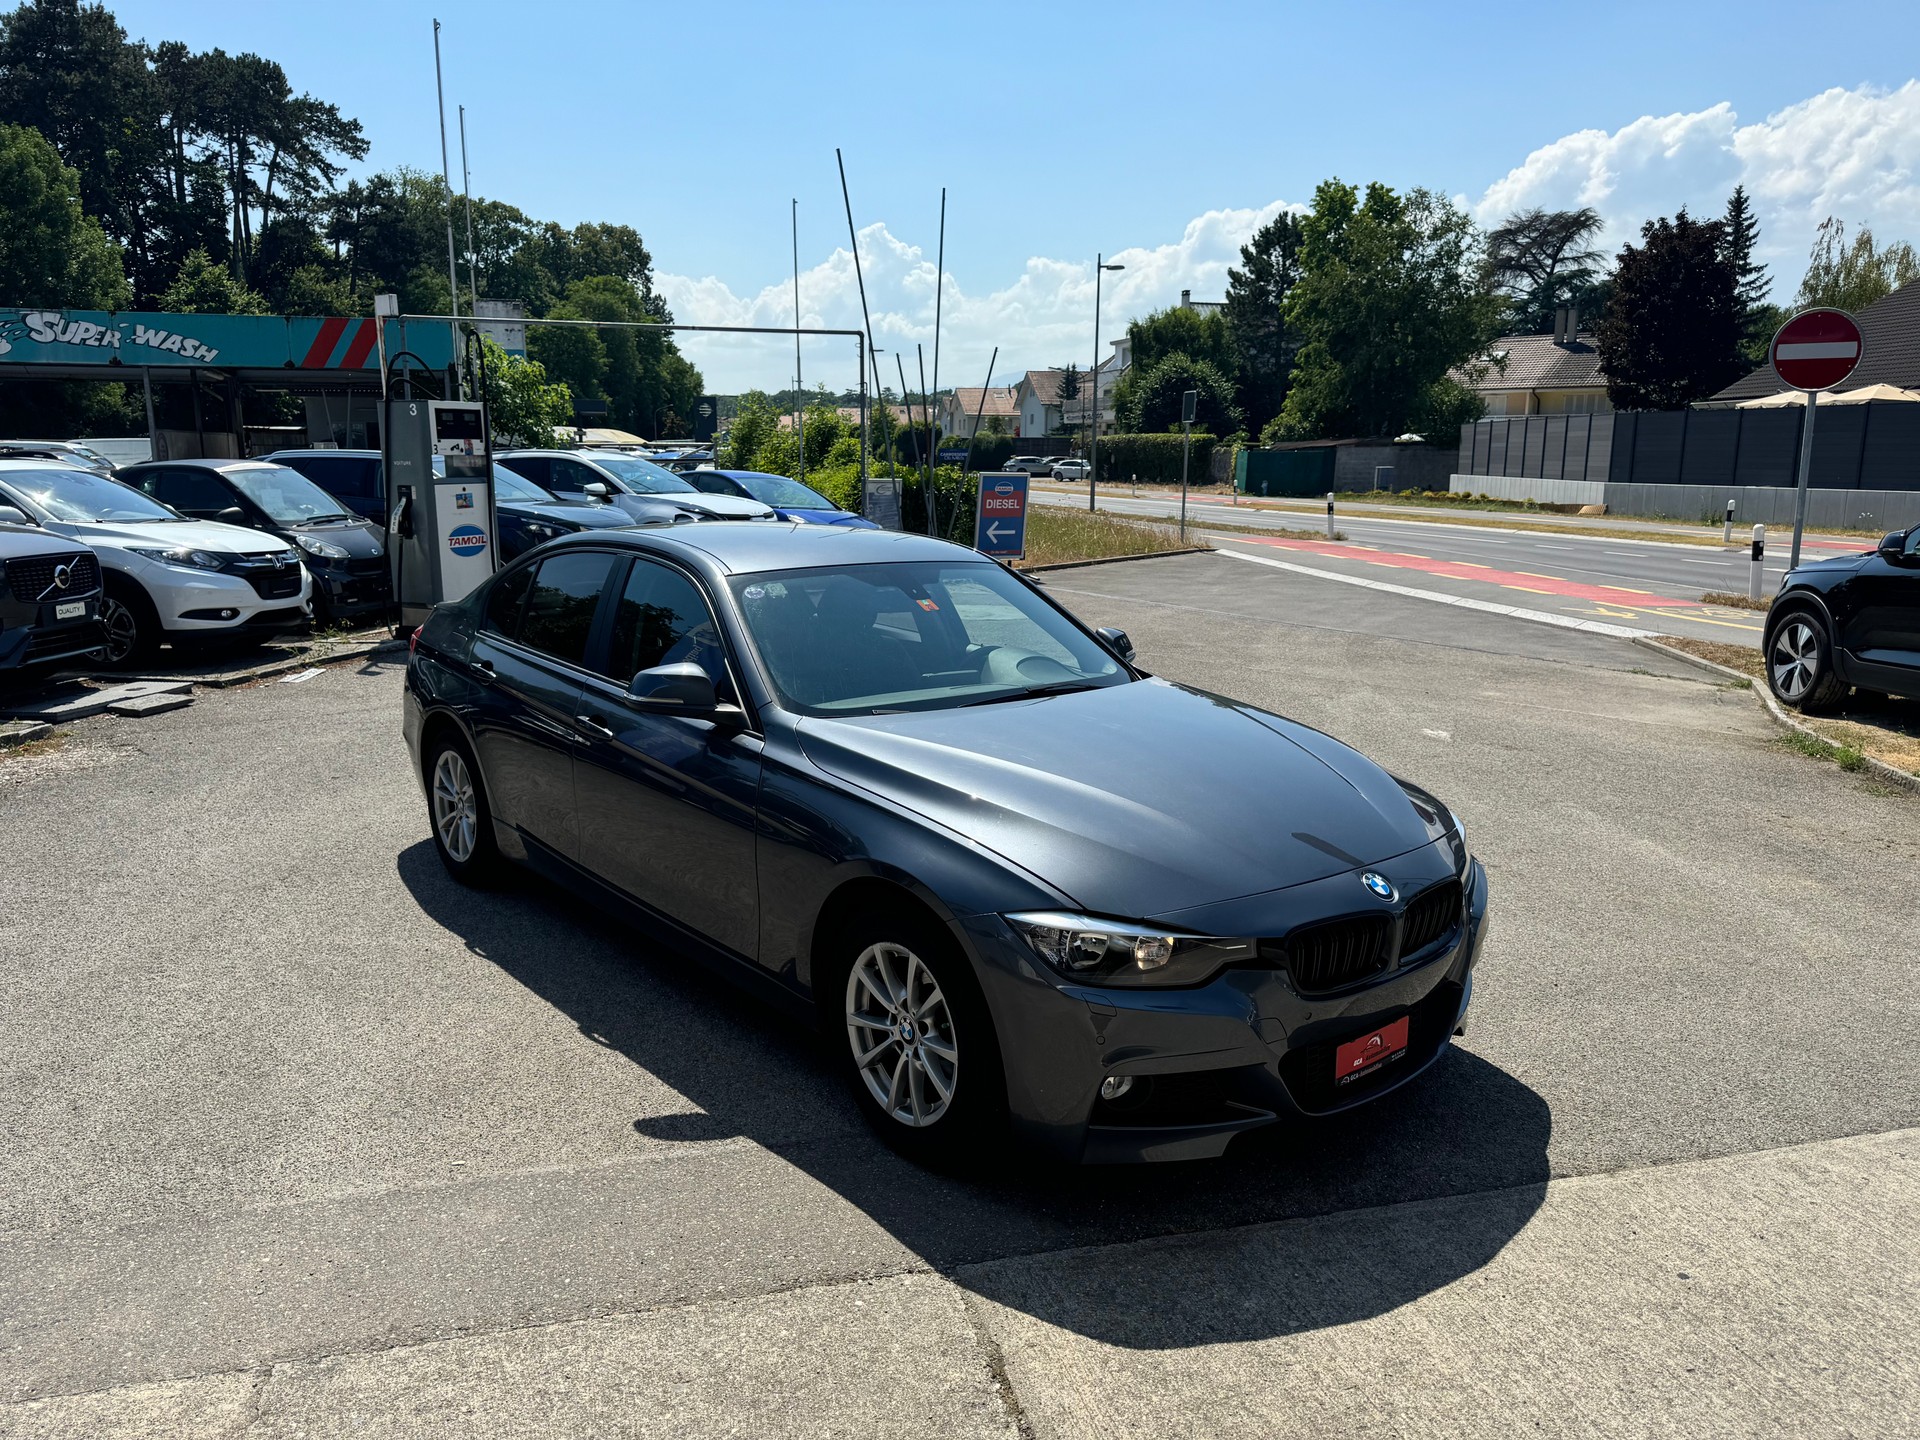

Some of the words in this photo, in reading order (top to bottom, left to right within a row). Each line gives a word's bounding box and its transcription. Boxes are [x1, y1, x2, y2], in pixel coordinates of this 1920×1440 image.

[24, 312, 121, 348] SUPER
[134, 324, 219, 363] WASH
[409, 403, 417, 416] 3
[433, 444, 439, 455] 3
[986, 499, 1020, 509] DIESEL
[448, 535, 488, 547] TAMOIL
